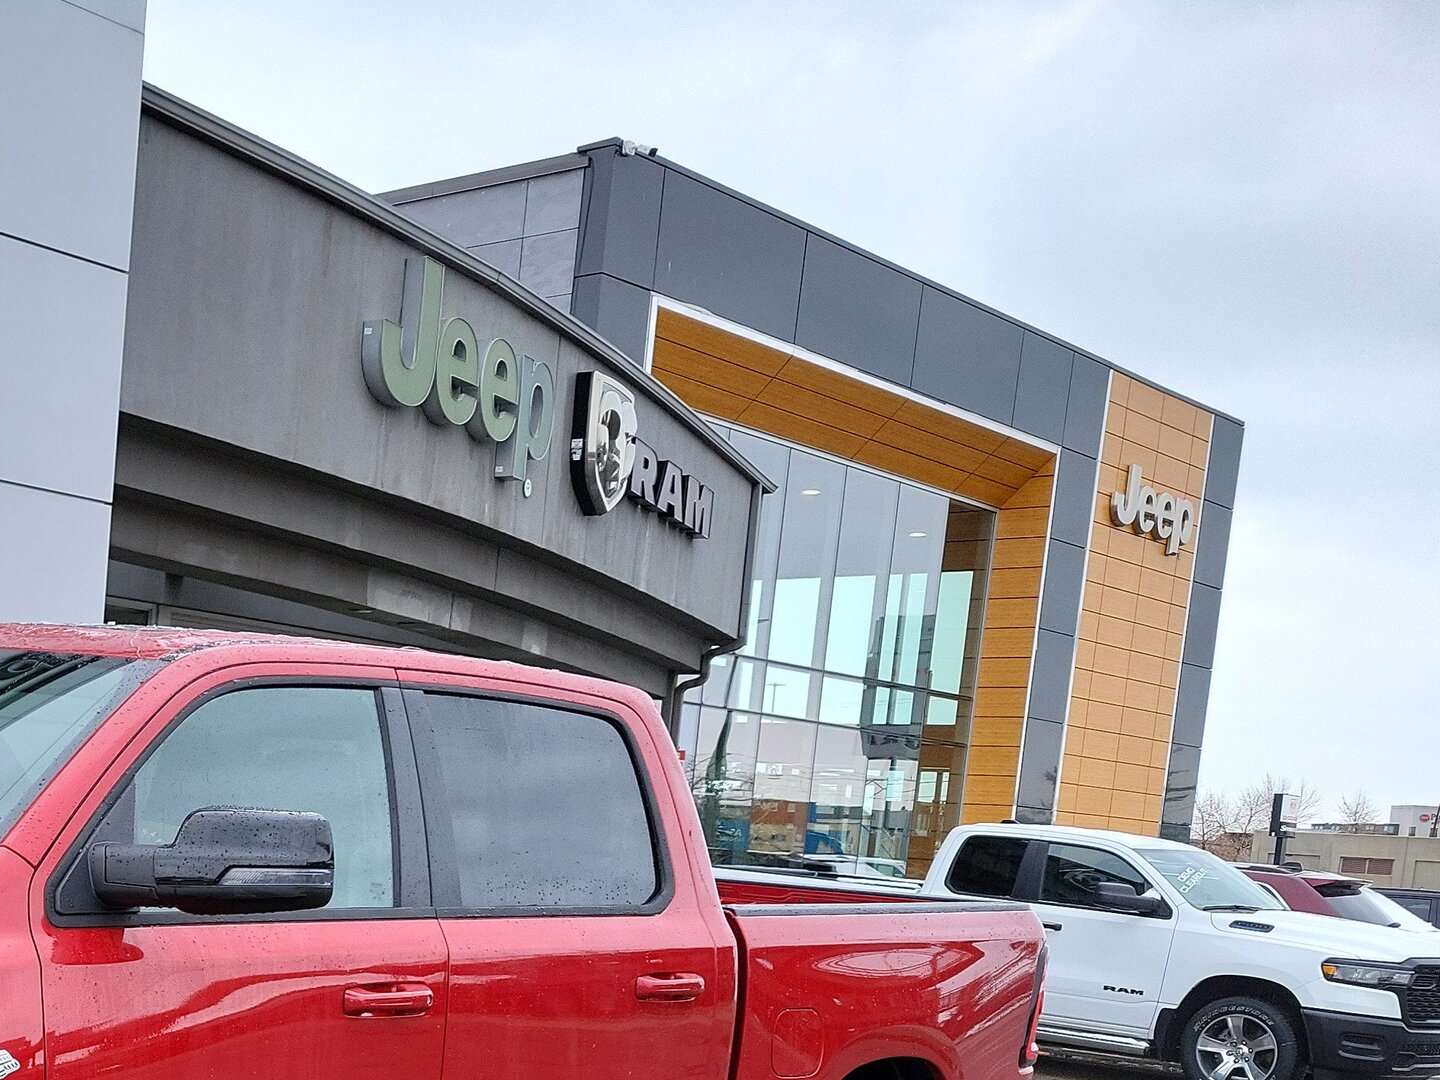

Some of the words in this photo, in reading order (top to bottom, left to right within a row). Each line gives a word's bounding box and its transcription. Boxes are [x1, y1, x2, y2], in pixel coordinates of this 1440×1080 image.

[362, 255, 555, 481] Jeep
[627, 435, 715, 540] RAM
[1109, 464, 1194, 556] Jeep
[1103, 985, 1144, 996] RAM
